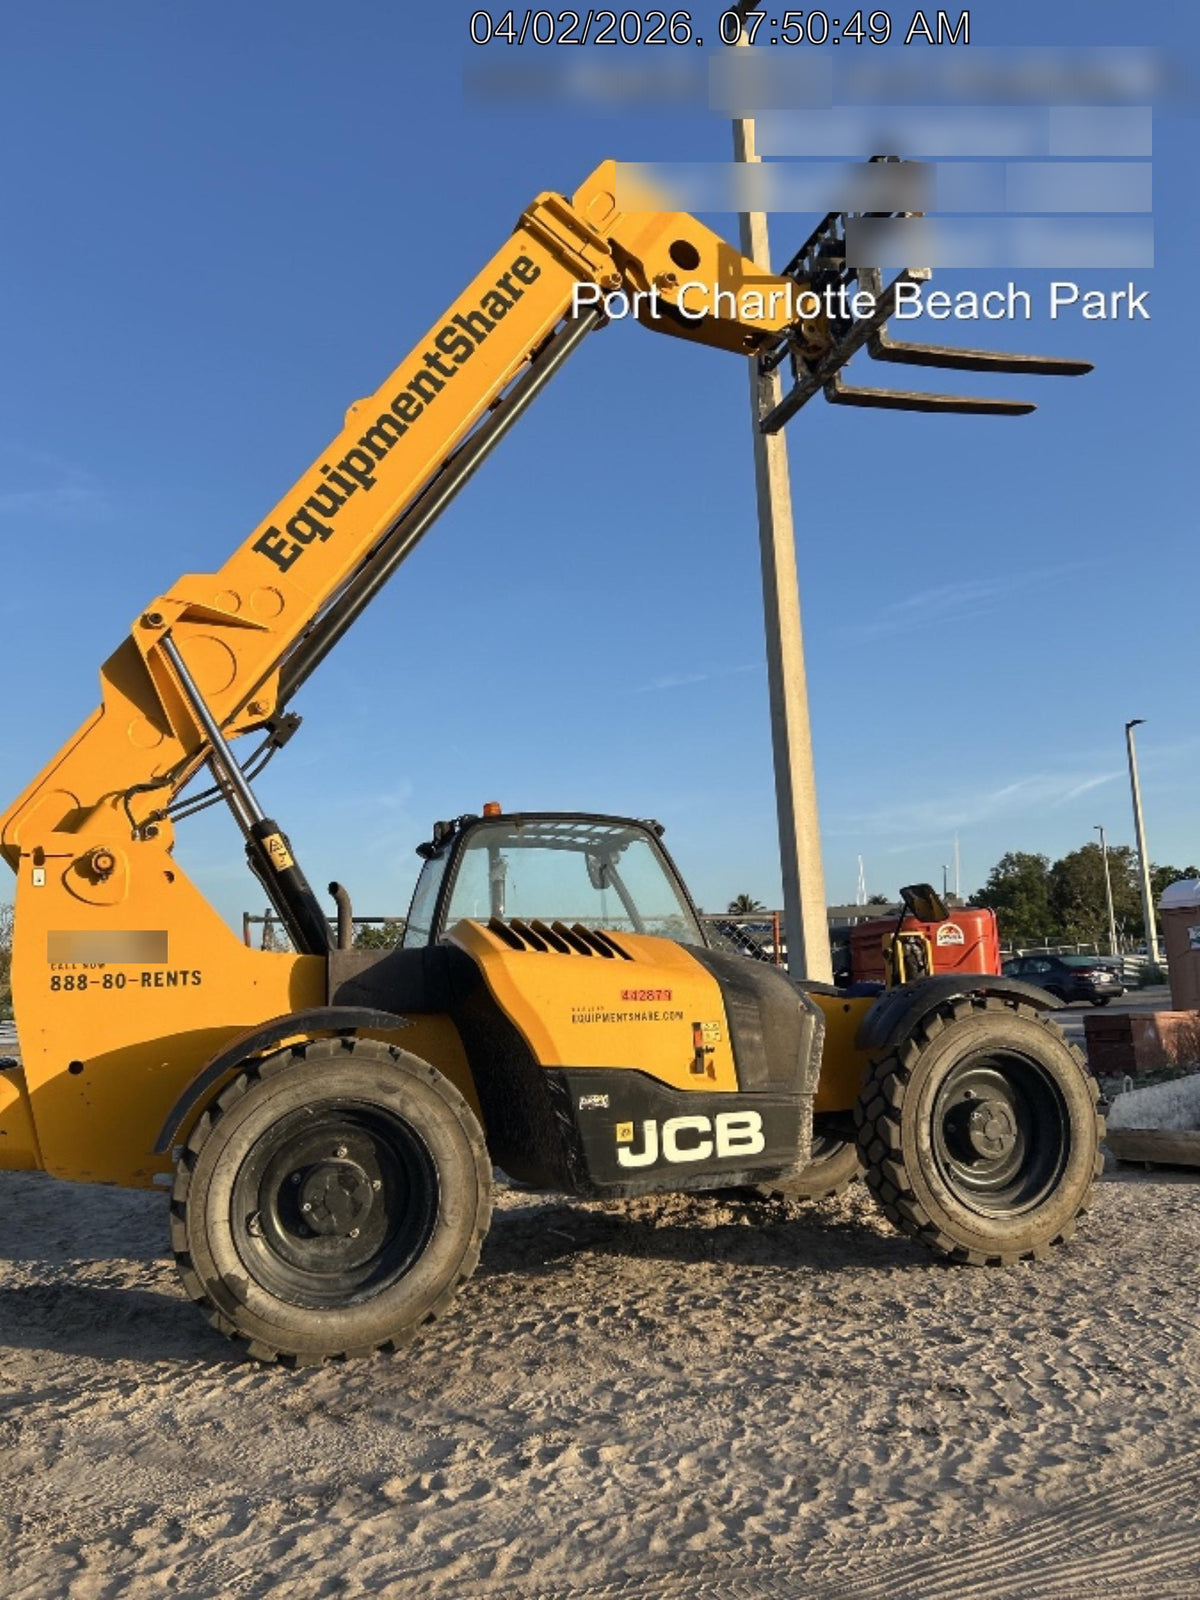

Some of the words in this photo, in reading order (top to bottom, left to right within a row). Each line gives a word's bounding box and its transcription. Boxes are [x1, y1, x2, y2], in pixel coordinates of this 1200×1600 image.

[251, 255, 541, 573] EquipmentShare
[50, 970, 202, 991] 888-80-RENTS
[571, 1011, 683, 1024] EQUIPMENTSHARE.COM
[617, 1110, 765, 1168] JCB
